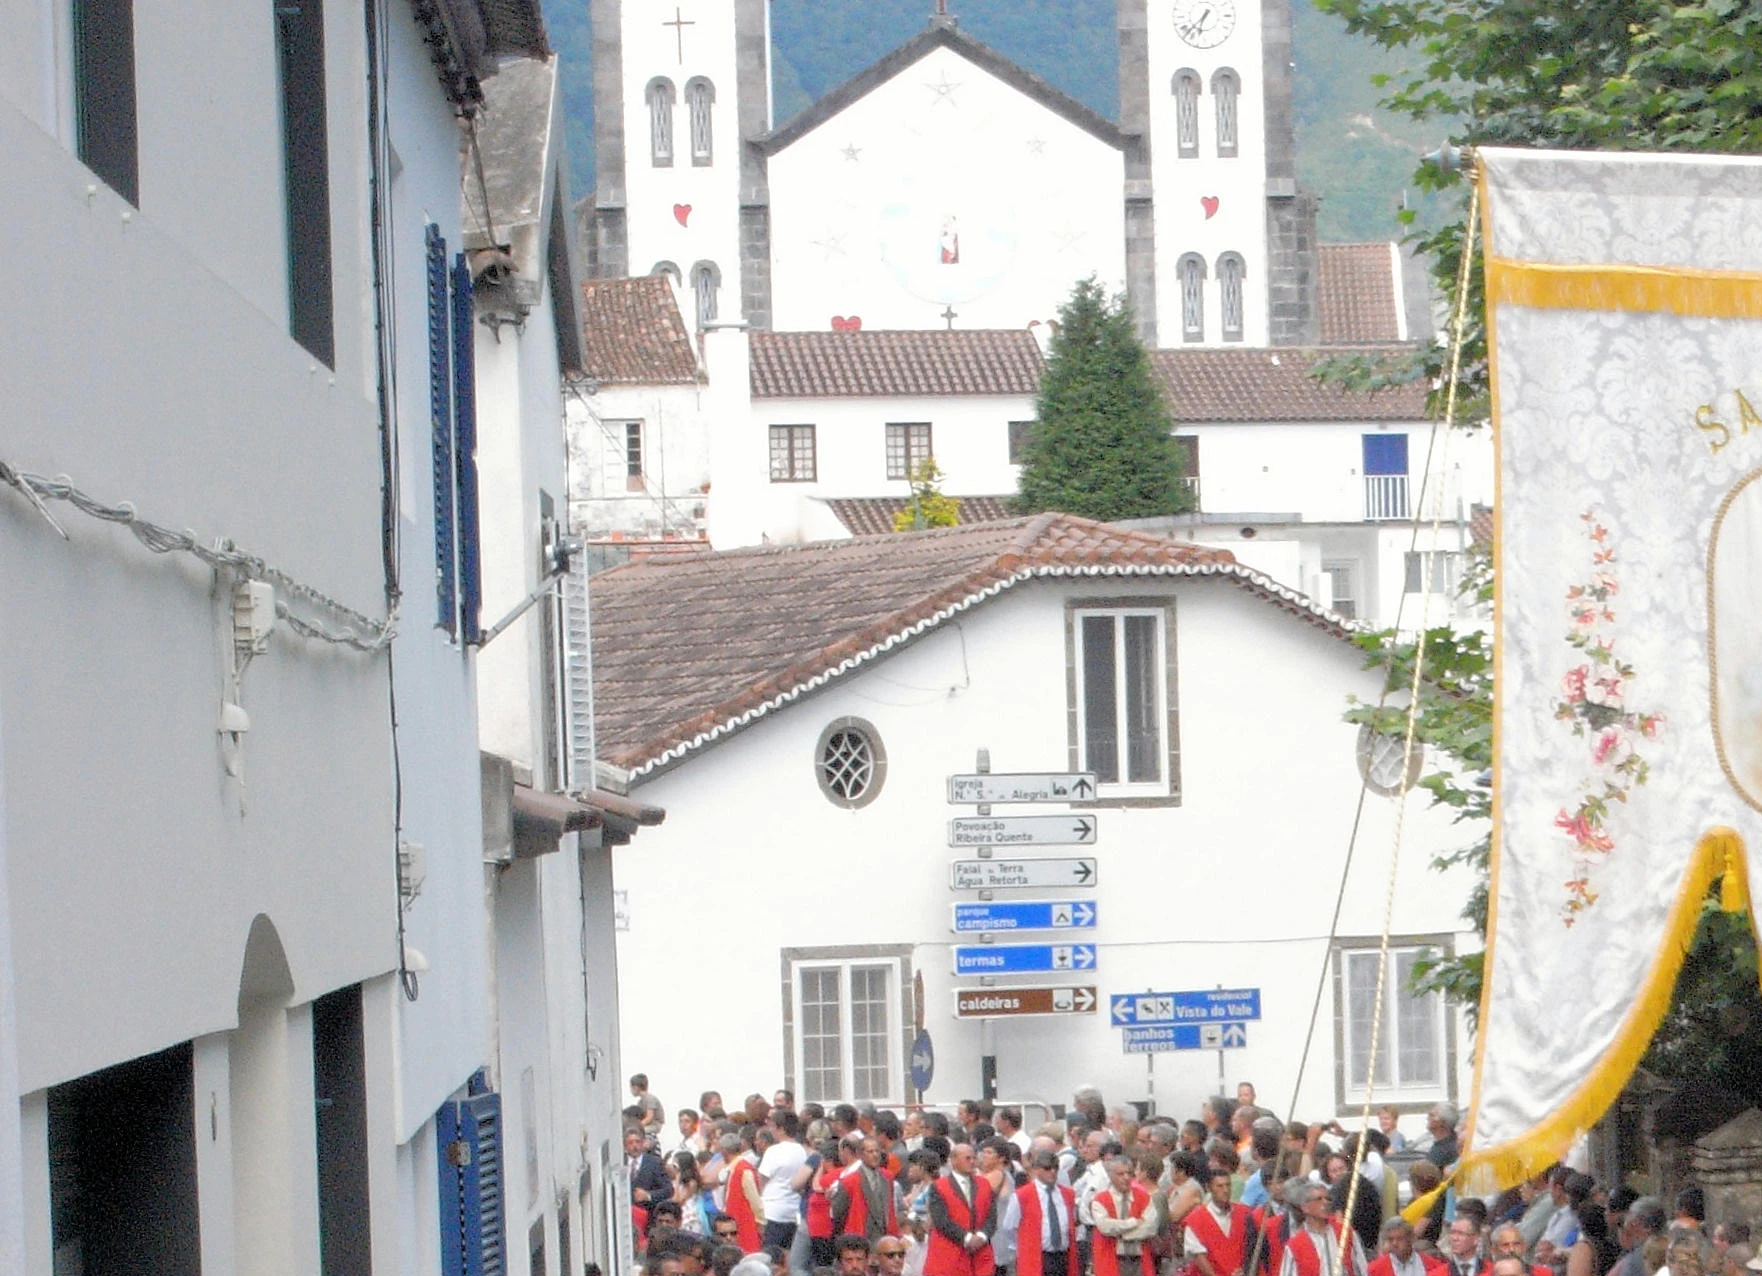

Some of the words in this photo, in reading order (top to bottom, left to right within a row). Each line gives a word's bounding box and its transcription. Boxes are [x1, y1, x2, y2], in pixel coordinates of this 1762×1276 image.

[1012, 790, 1048, 801] Alegria
[955, 833, 992, 843] Ribeira
[995, 832, 1033, 843] Quente
[998, 863, 1024, 873] Terra
[958, 917, 1018, 930] campismo
[959, 956, 1005, 968] termas
[959, 997, 1021, 1010] caldeiras
[1176, 1005, 1208, 1019] Vista
[1210, 1004, 1226, 1017] do
[1227, 1003, 1253, 1017] Vale
